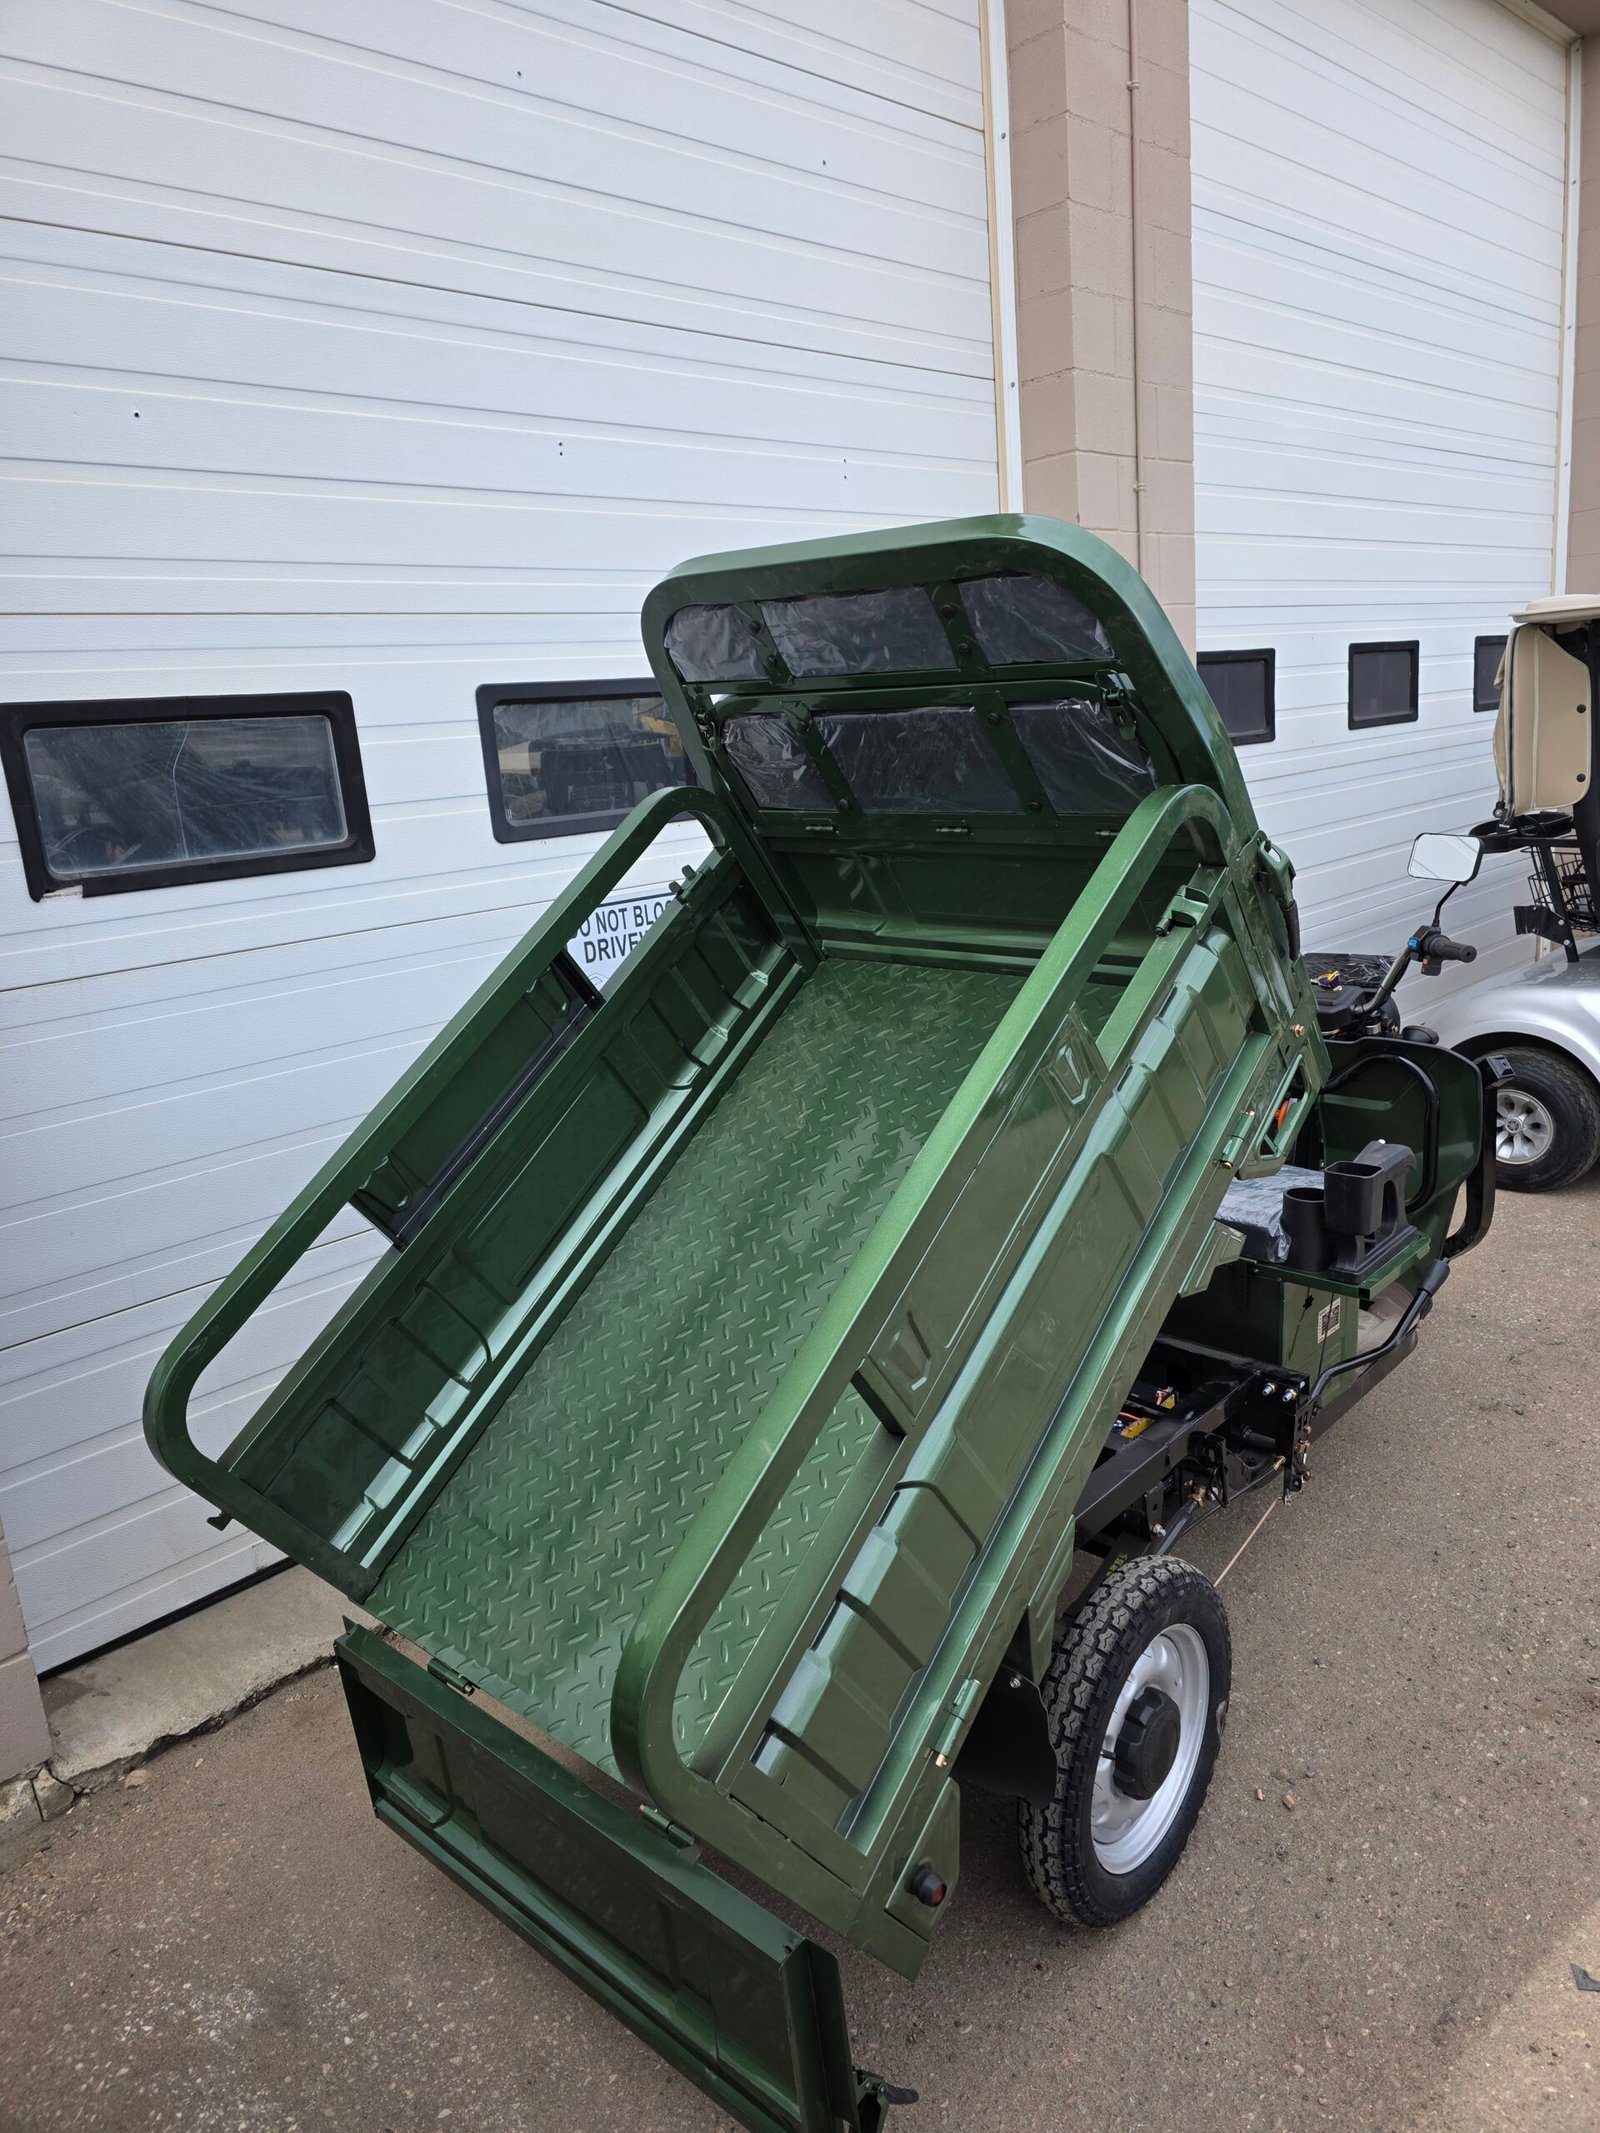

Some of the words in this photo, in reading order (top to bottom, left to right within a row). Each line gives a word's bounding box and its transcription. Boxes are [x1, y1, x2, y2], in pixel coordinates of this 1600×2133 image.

[595, 907, 628, 934] NOT
[633, 900, 671, 927] BLO
[583, 931, 646, 963] DRIVE
